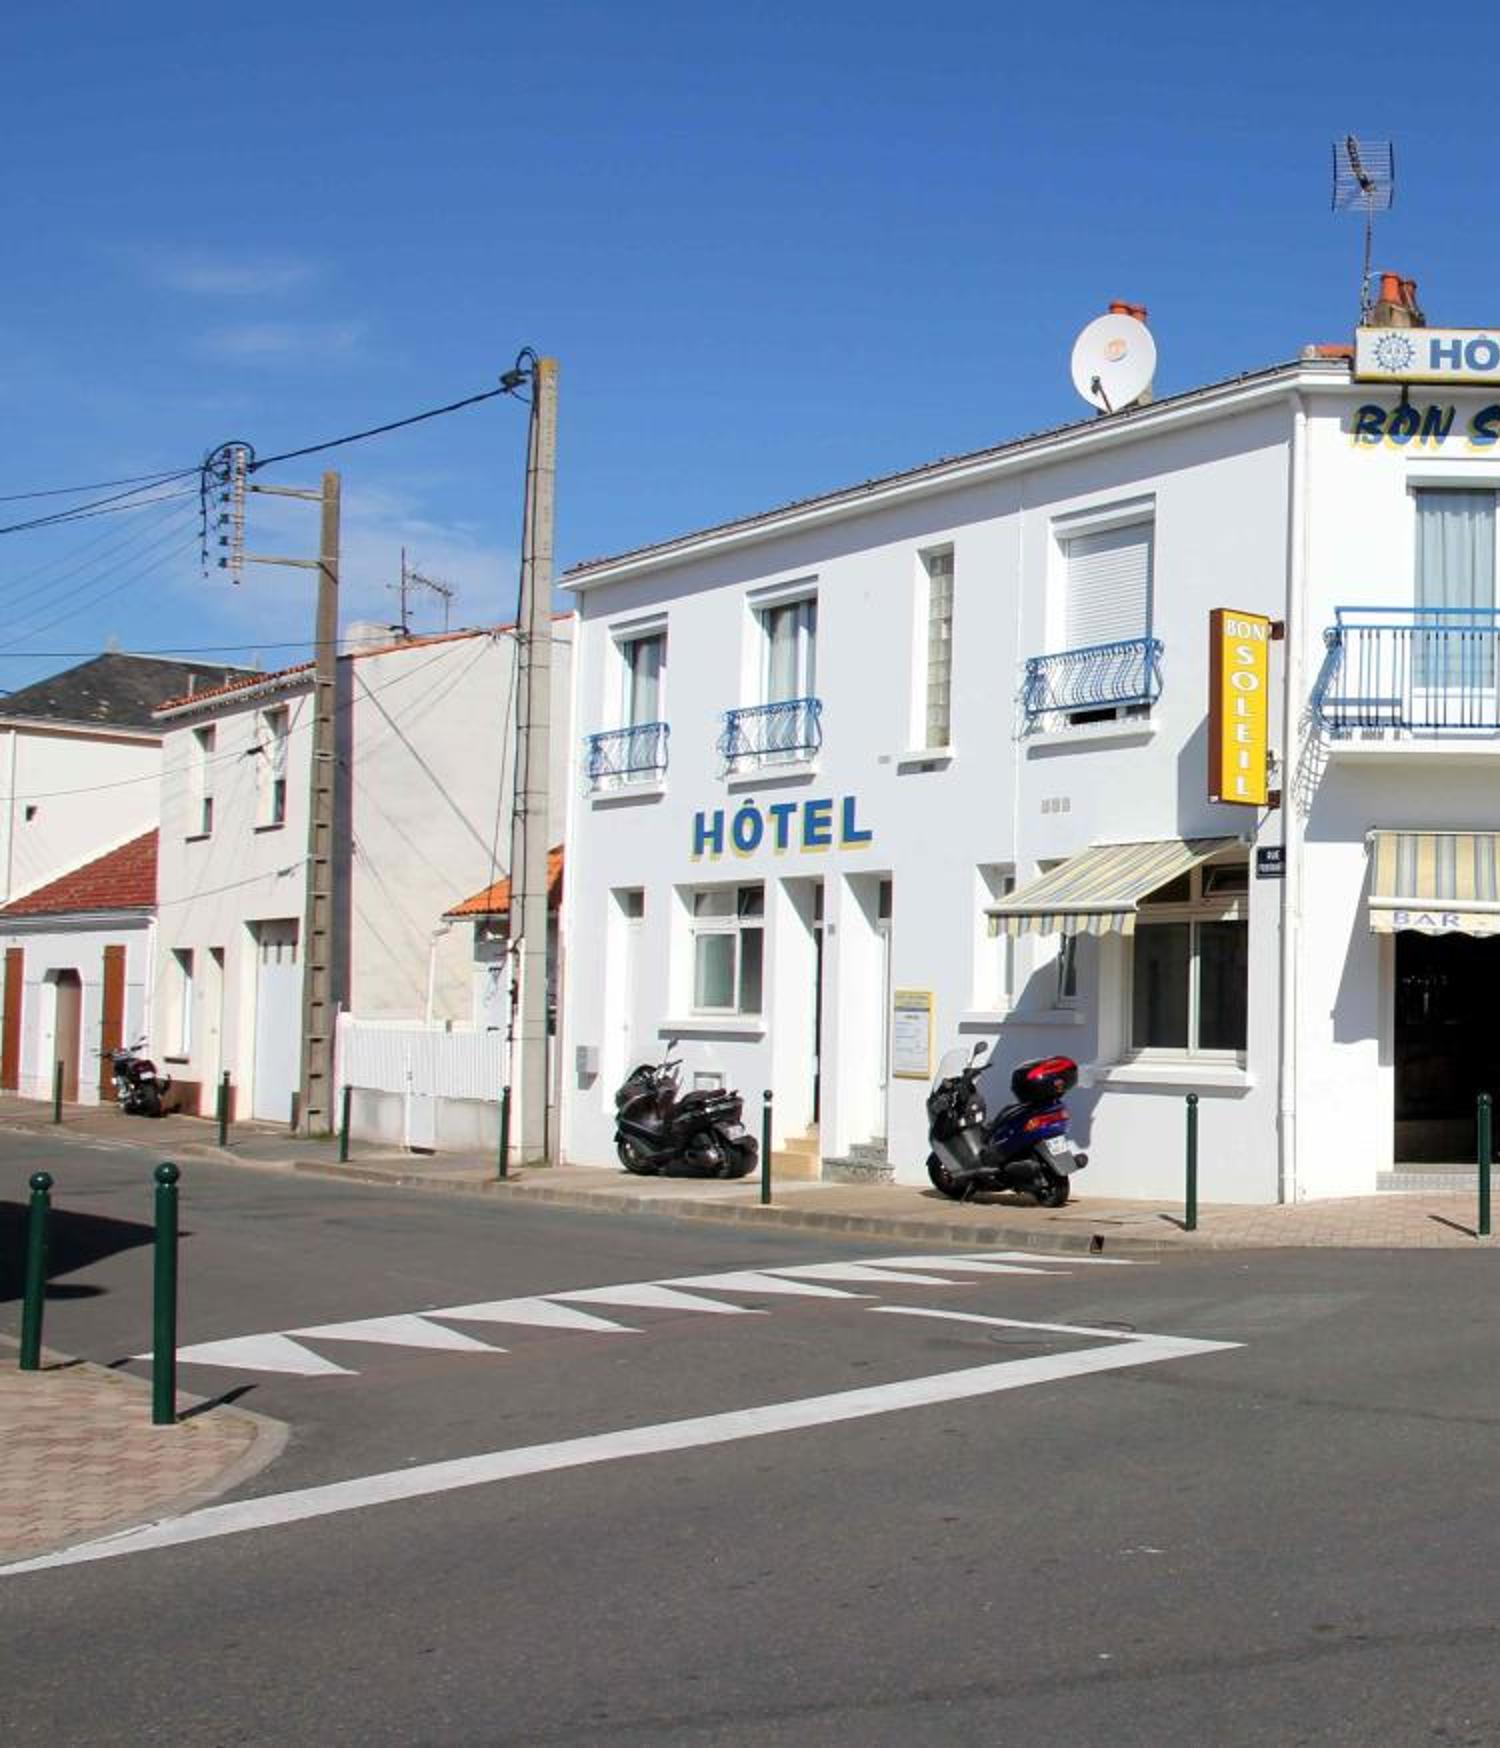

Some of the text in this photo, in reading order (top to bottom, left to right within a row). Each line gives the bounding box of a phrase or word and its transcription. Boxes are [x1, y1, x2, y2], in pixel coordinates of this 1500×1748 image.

[1352, 403, 1456, 449] BON
[1226, 618, 1266, 641] BON
[1231, 645, 1259, 796] SOLEIL
[691, 796, 874, 859] HÔTEL
[1393, 911, 1460, 927] BAR
